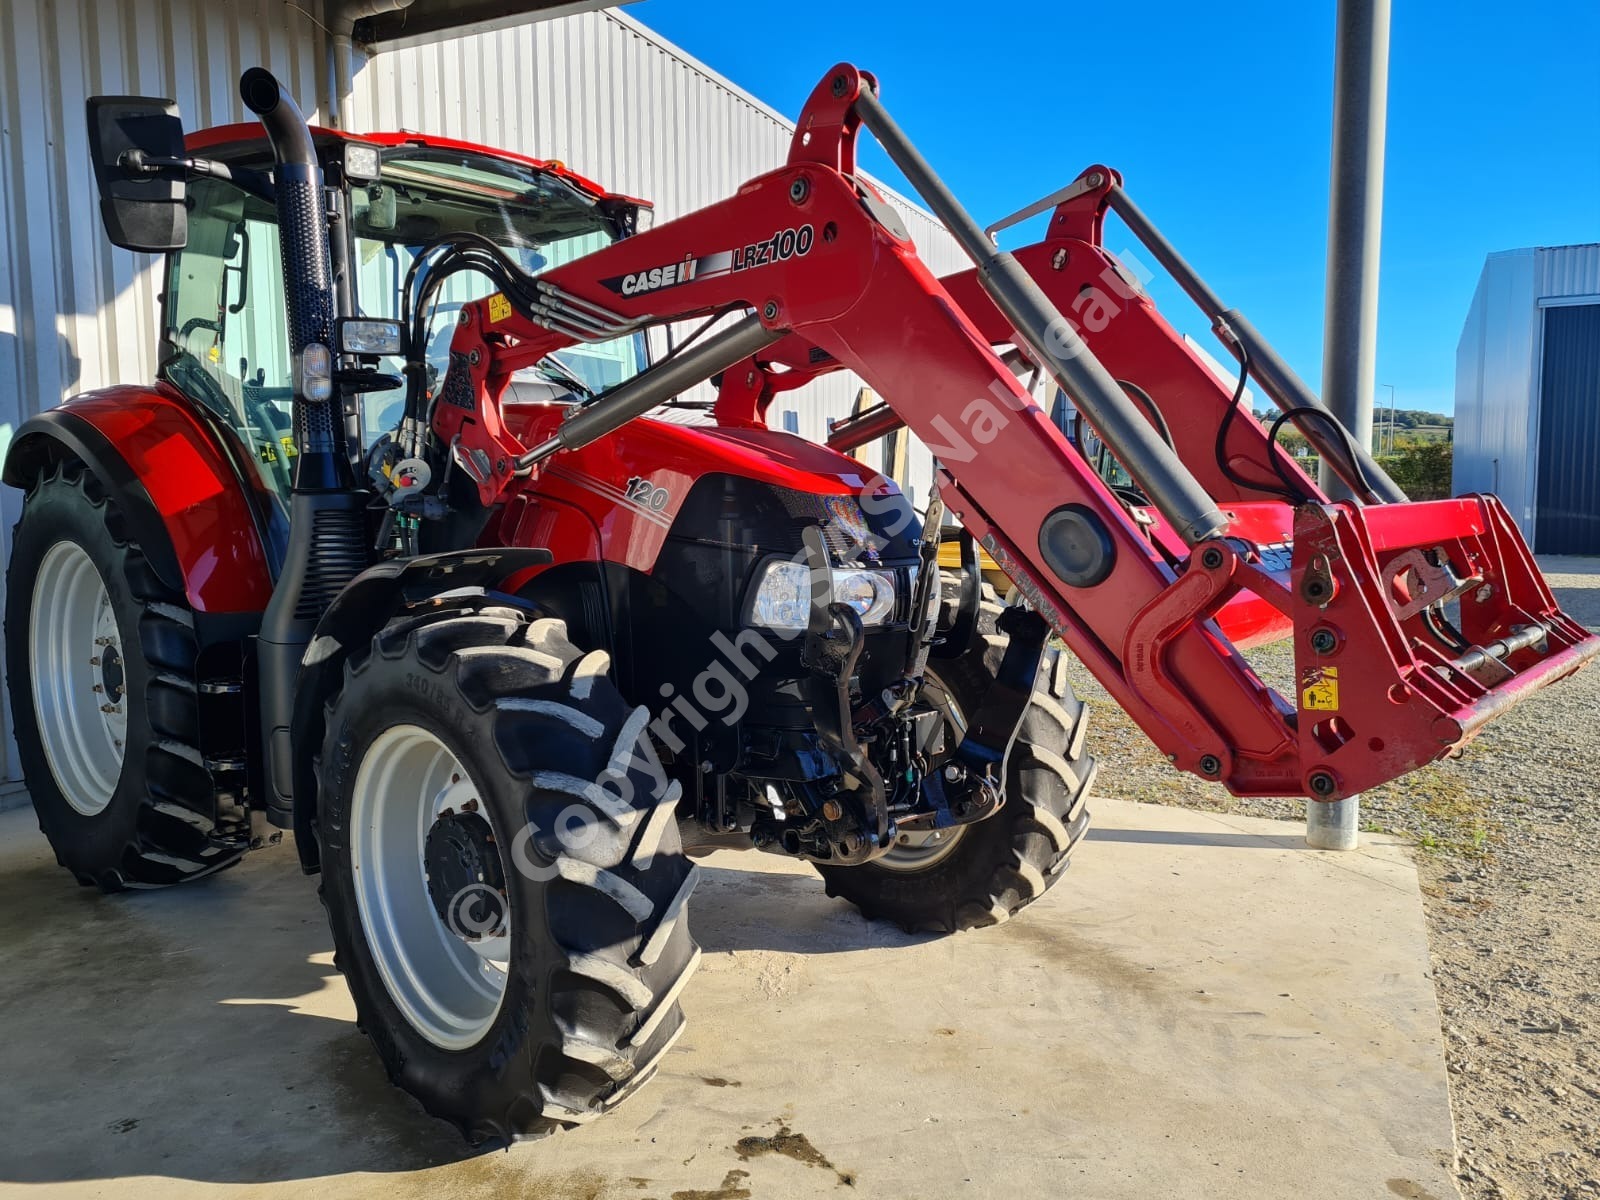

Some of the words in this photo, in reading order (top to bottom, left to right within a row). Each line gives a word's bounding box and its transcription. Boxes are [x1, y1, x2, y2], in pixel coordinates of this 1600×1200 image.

[621, 264, 678, 296] CASE
[731, 223, 814, 273] LRZ100
[623, 475, 670, 513] 120
